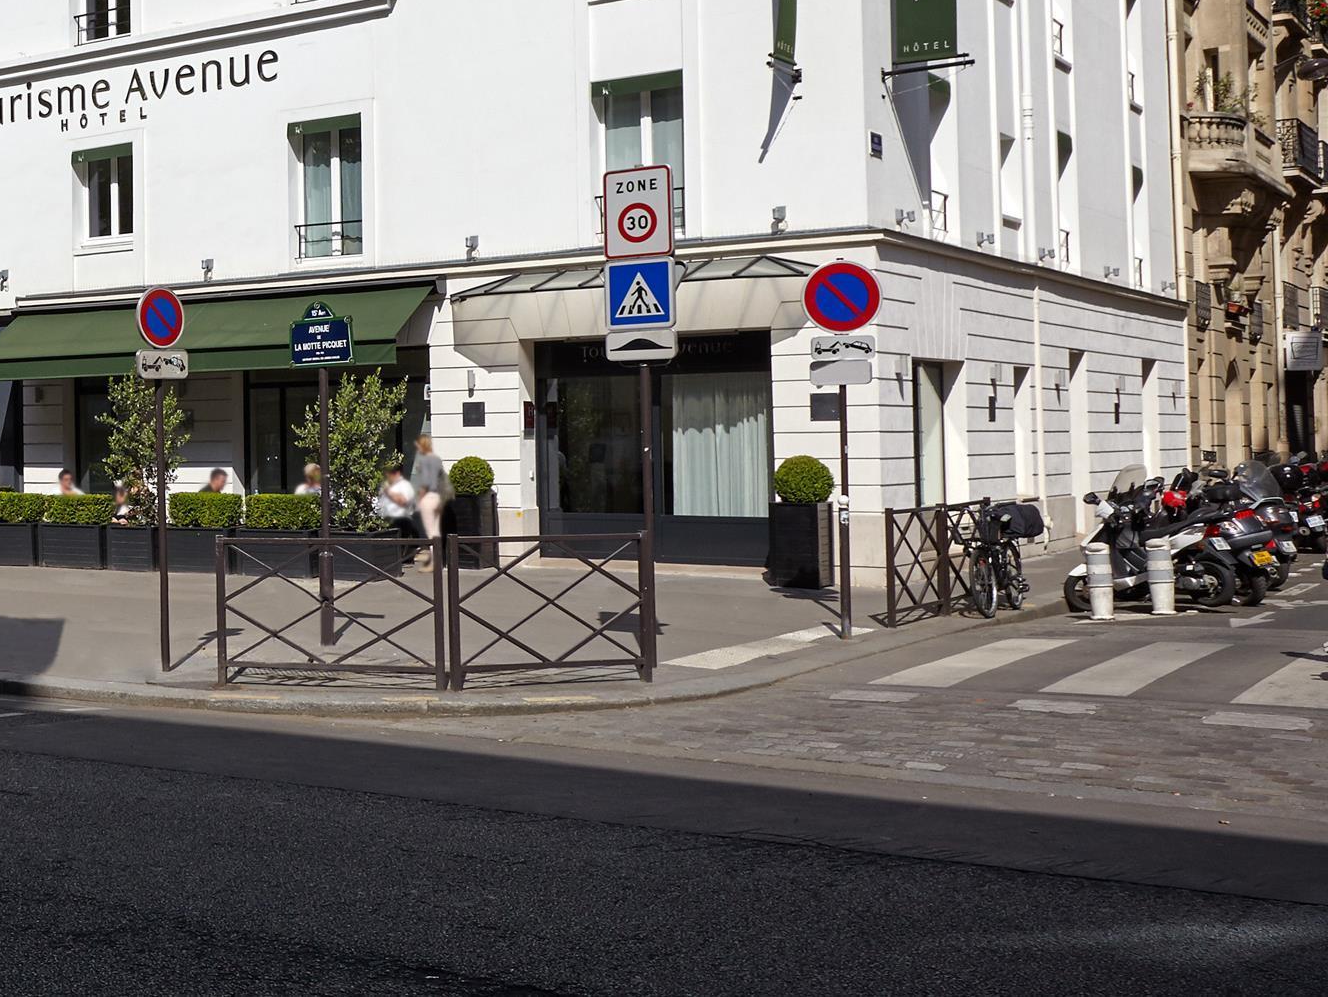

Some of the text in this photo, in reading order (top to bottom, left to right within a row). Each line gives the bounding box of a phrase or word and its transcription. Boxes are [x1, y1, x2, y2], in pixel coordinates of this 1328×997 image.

[903, 40, 950, 53] HÔTEL
[124, 49, 279, 104] Avenue
[60, 107, 148, 132] HÔTEL
[616, 178, 658, 194] ZONE
[626, 214, 649, 231] 30
[308, 324, 331, 334] AVENUE
[294, 339, 348, 352] LA MOTTE PICQUET
